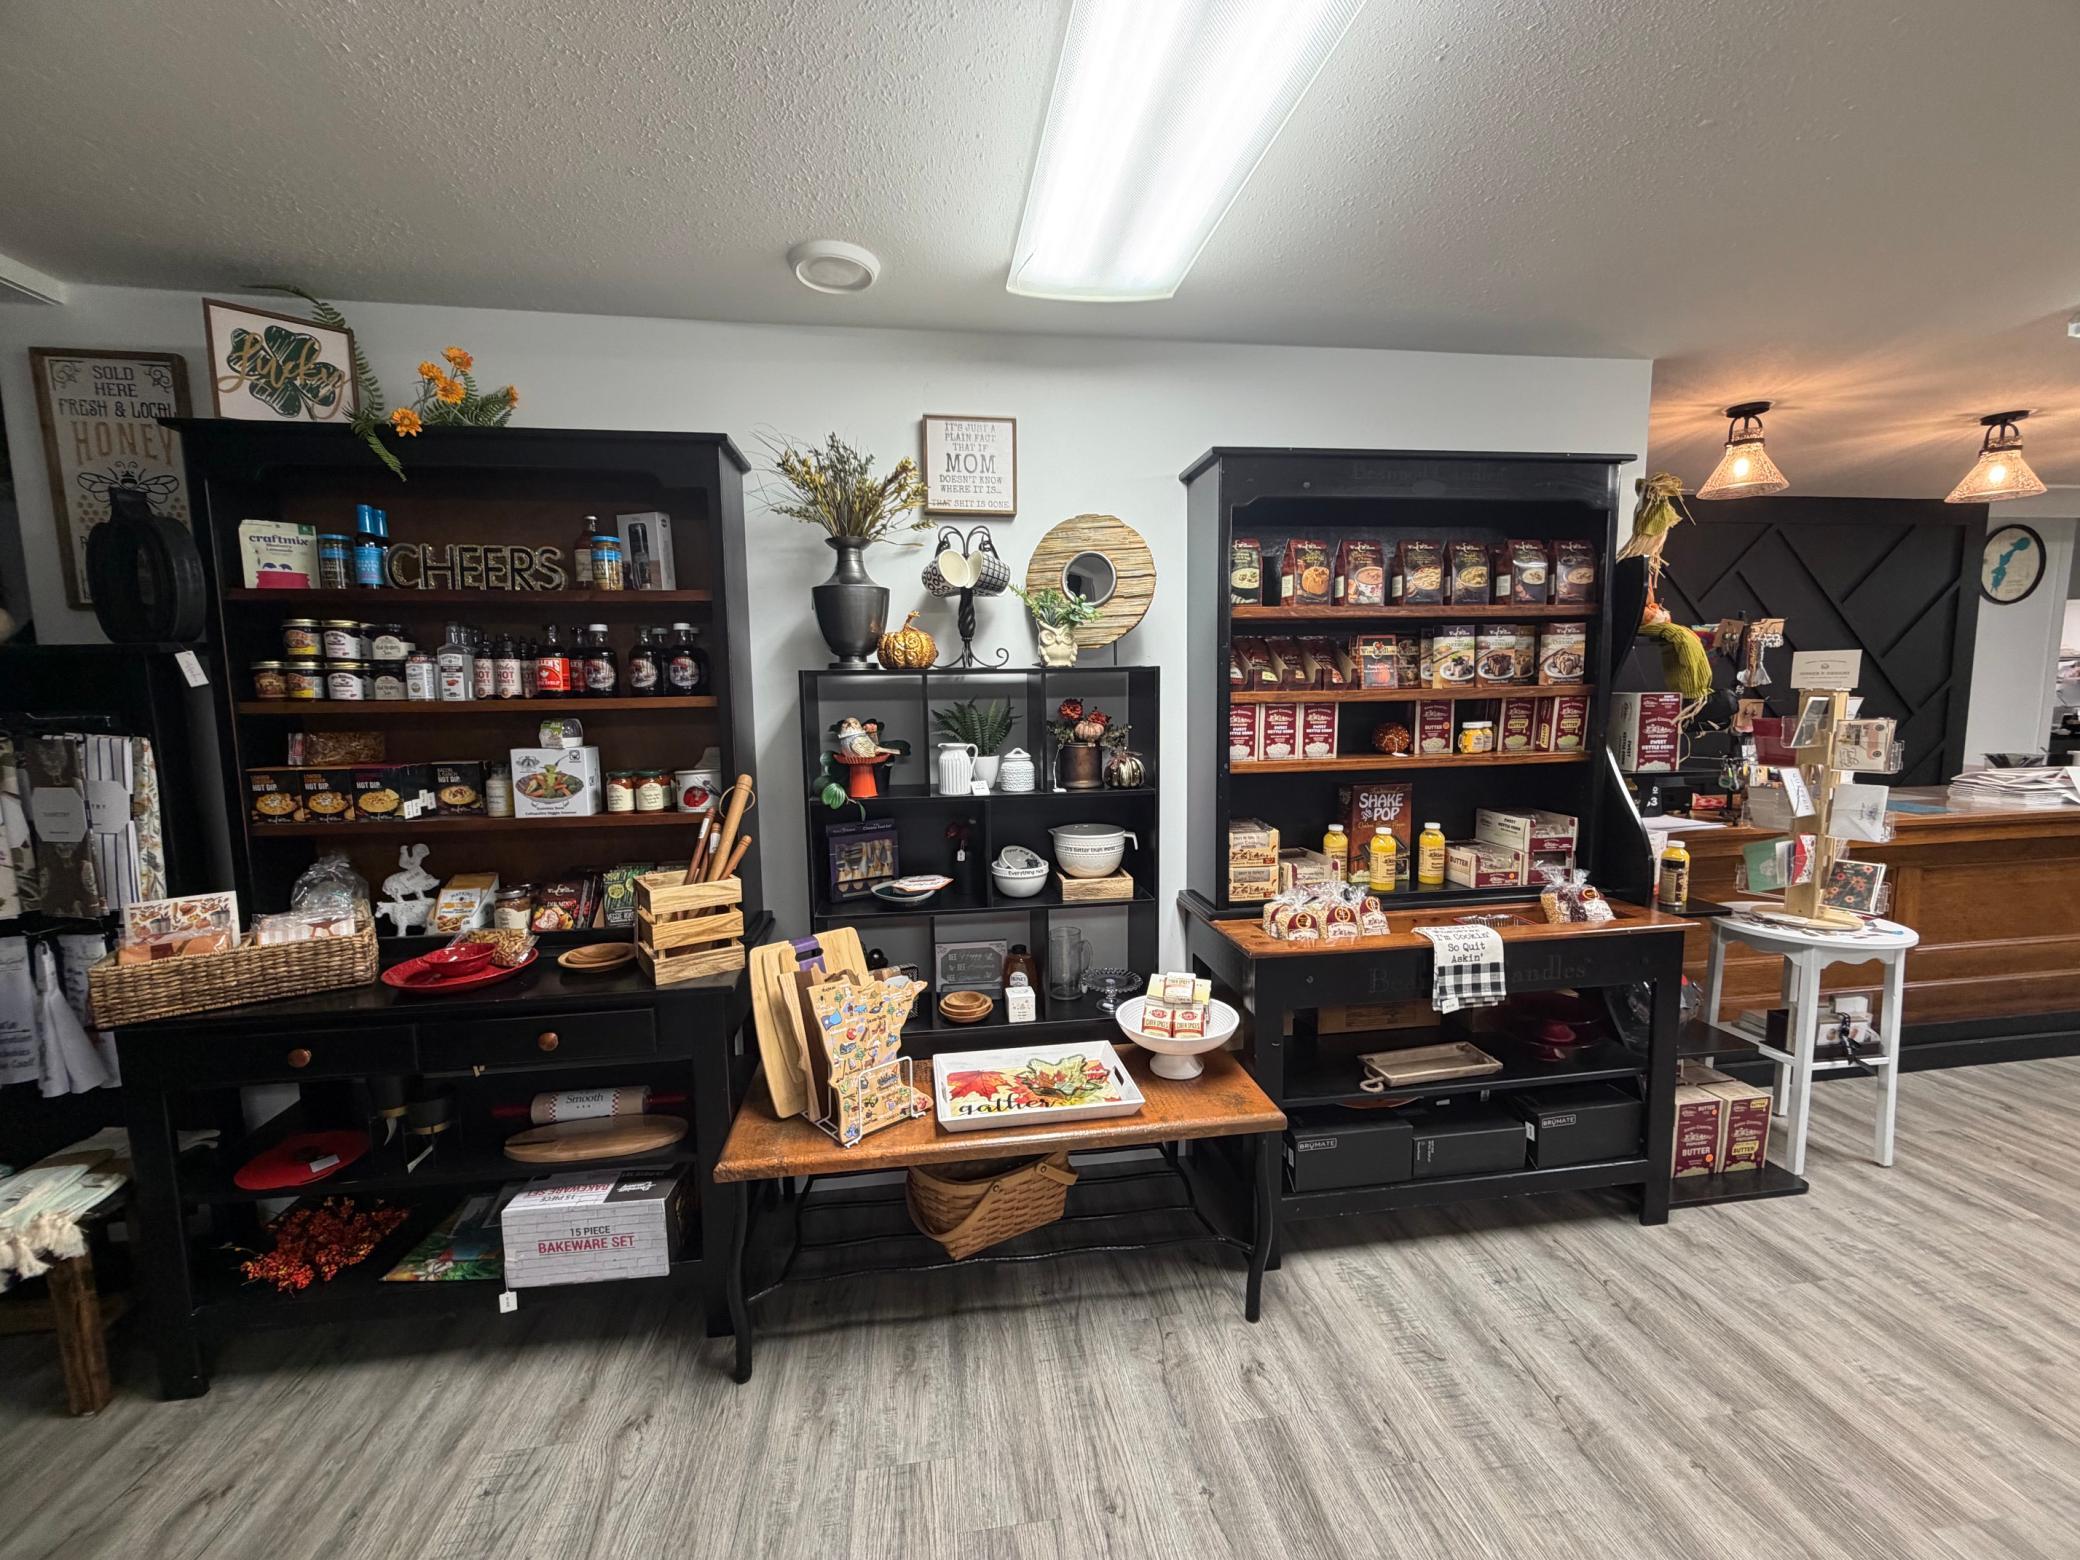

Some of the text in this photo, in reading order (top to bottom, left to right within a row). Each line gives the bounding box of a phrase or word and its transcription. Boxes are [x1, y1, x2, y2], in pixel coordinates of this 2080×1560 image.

[92, 365, 135, 381] SOLD
[219, 331, 352, 419] Lucky
[93, 382, 138, 398] HERE
[58, 399, 177, 420] FRESH & LOCAL
[944, 422, 997, 433] IT'S JUST A
[70, 420, 176, 467] HONEY
[944, 432, 997, 443] PLAIN FACT
[952, 443, 989, 452] THAT IF
[945, 452, 997, 474] MOM
[939, 474, 1002, 485] DOESN'T KNOW
[940, 484, 971, 494] WHERE
[973, 485, 984, 494] IT
[953, 499, 976, 507] SHIT
[977, 500, 987, 508] IS
[988, 501, 1010, 509] GONE
[249, 534, 309, 546] craftmix
[386, 543, 568, 591] CHEERS
[1359, 792, 1404, 808] SHAKE
[1373, 807, 1401, 821] POP
[1450, 855, 1469, 867] BUTTER
[1453, 931, 1490, 941] Cookin'
[1448, 942, 1486, 952] So Quit
[1451, 953, 1484, 964] Askin'
[1157, 1020, 1169, 1029] SPICES
[565, 1093, 604, 1104] Smooth
[959, 1093, 1055, 1115] gather
[1697, 1104, 1716, 1112] BUTTER
[1682, 1146, 1711, 1157] BUTTER
[570, 1225, 611, 1237] 15 PIECE
[538, 1235, 635, 1254] BAKEWARE SET
